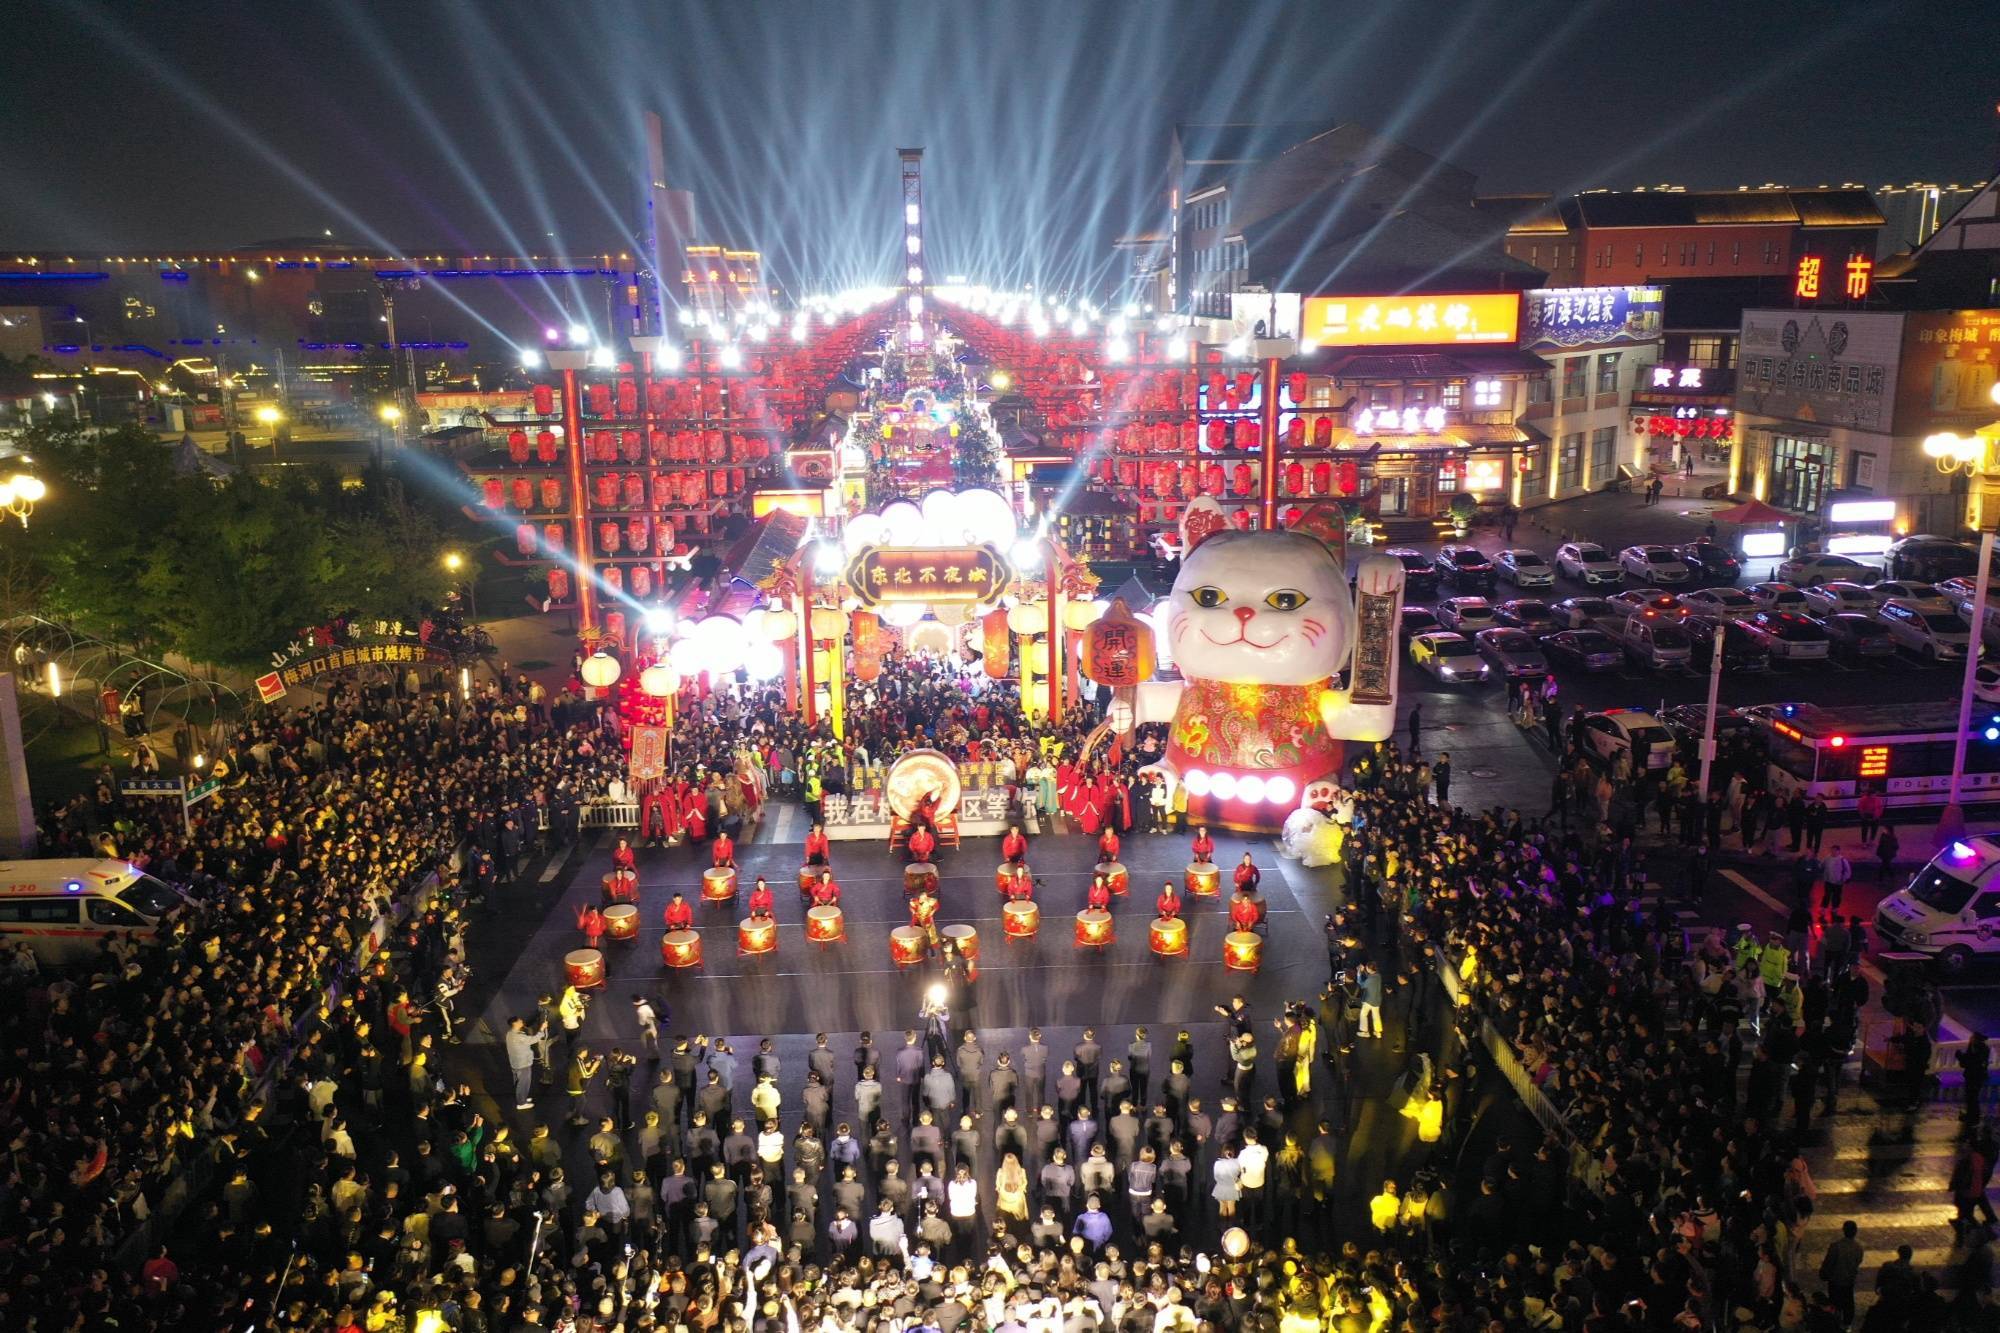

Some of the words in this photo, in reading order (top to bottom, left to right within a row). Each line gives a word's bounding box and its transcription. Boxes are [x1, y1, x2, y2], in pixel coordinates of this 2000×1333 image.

[1796, 256, 1872, 300] 超市
[1745, 357, 1886, 396] 中国名特优商品城
[870, 565, 987, 586] 东北不夜城
[283, 644, 426, 687] 梅河口首届城市烧烤节
[1893, 778, 1947, 789] POLIC
[9, 884, 37, 892] 120
